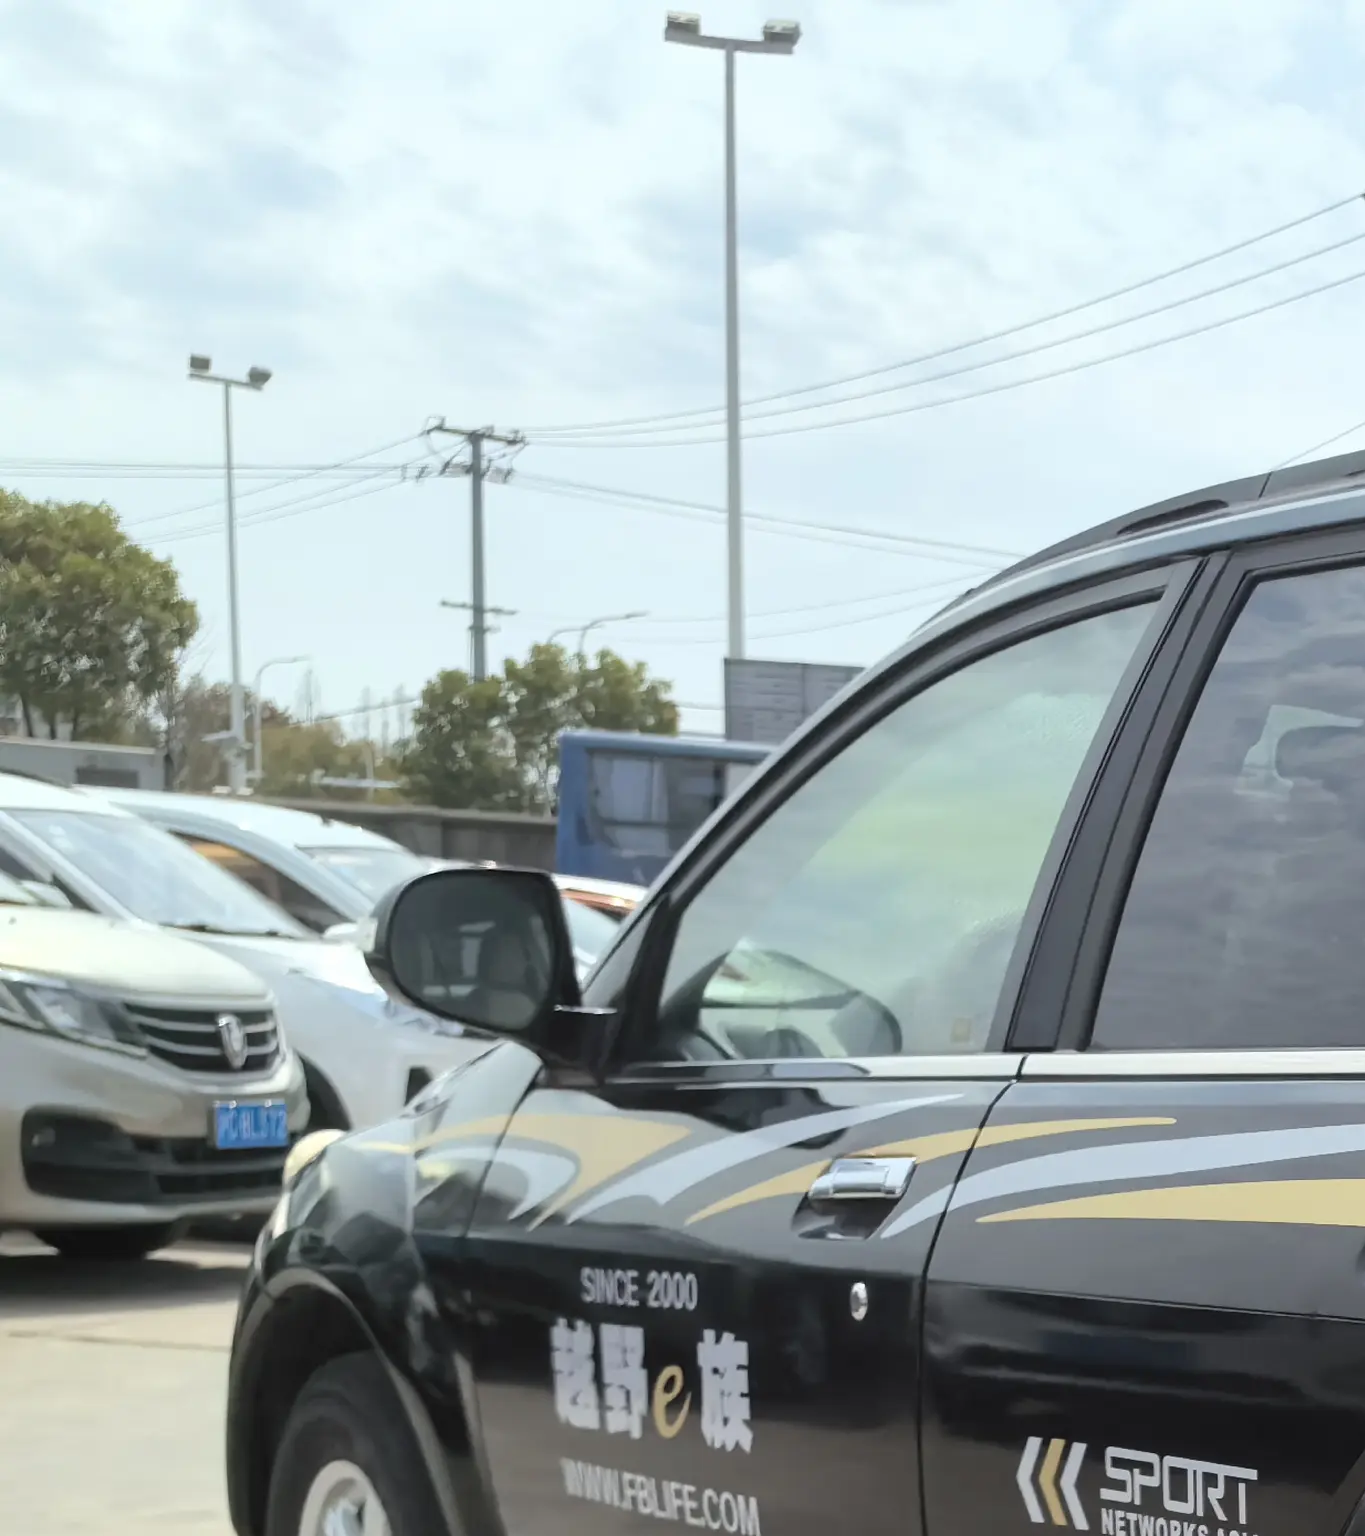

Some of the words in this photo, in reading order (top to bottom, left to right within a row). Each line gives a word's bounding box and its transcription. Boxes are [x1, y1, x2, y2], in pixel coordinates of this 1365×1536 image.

[580, 1266, 640, 1307] SINCE
[646, 1271, 699, 1311] 2000
[1100, 1446, 1258, 1525] SPORT
